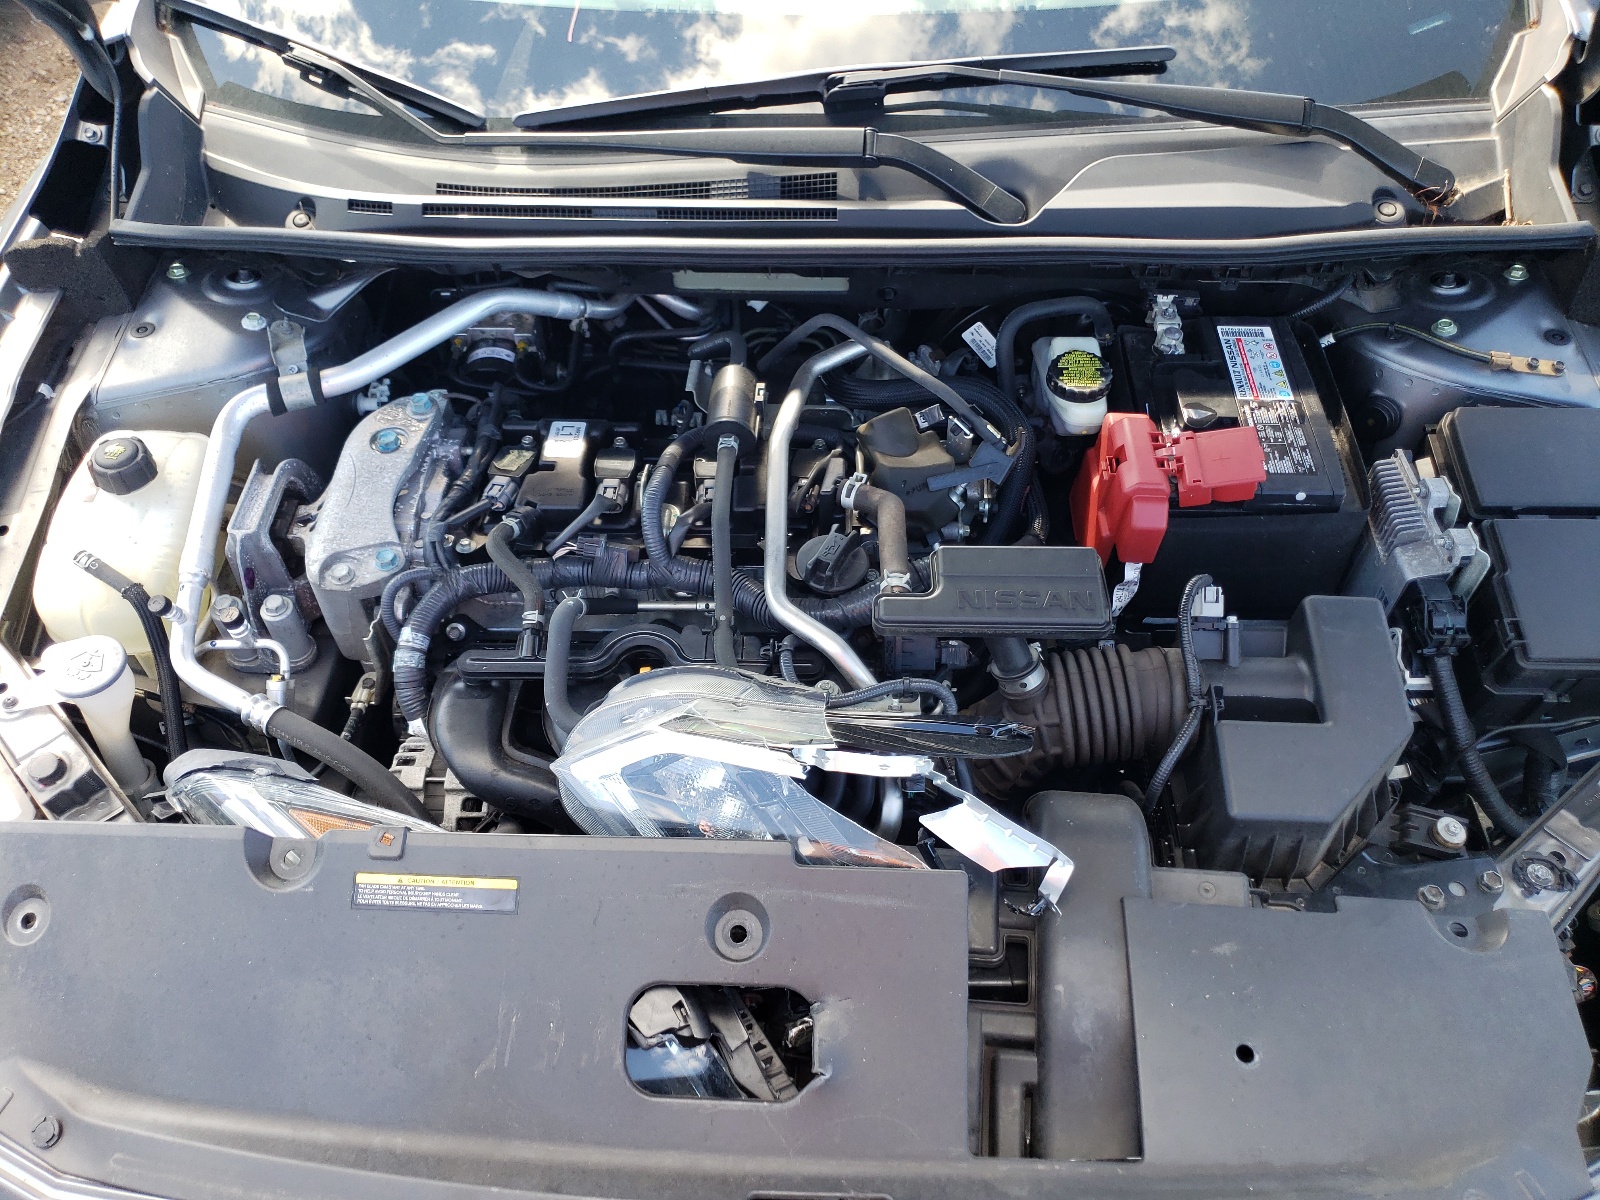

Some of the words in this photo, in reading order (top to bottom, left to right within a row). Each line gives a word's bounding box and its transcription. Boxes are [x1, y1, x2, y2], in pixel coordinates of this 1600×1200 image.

[1224, 338, 1238, 368] NISSAN
[1234, 368, 1247, 398] RENAULT
[956, 589, 1093, 612] NISSAN
